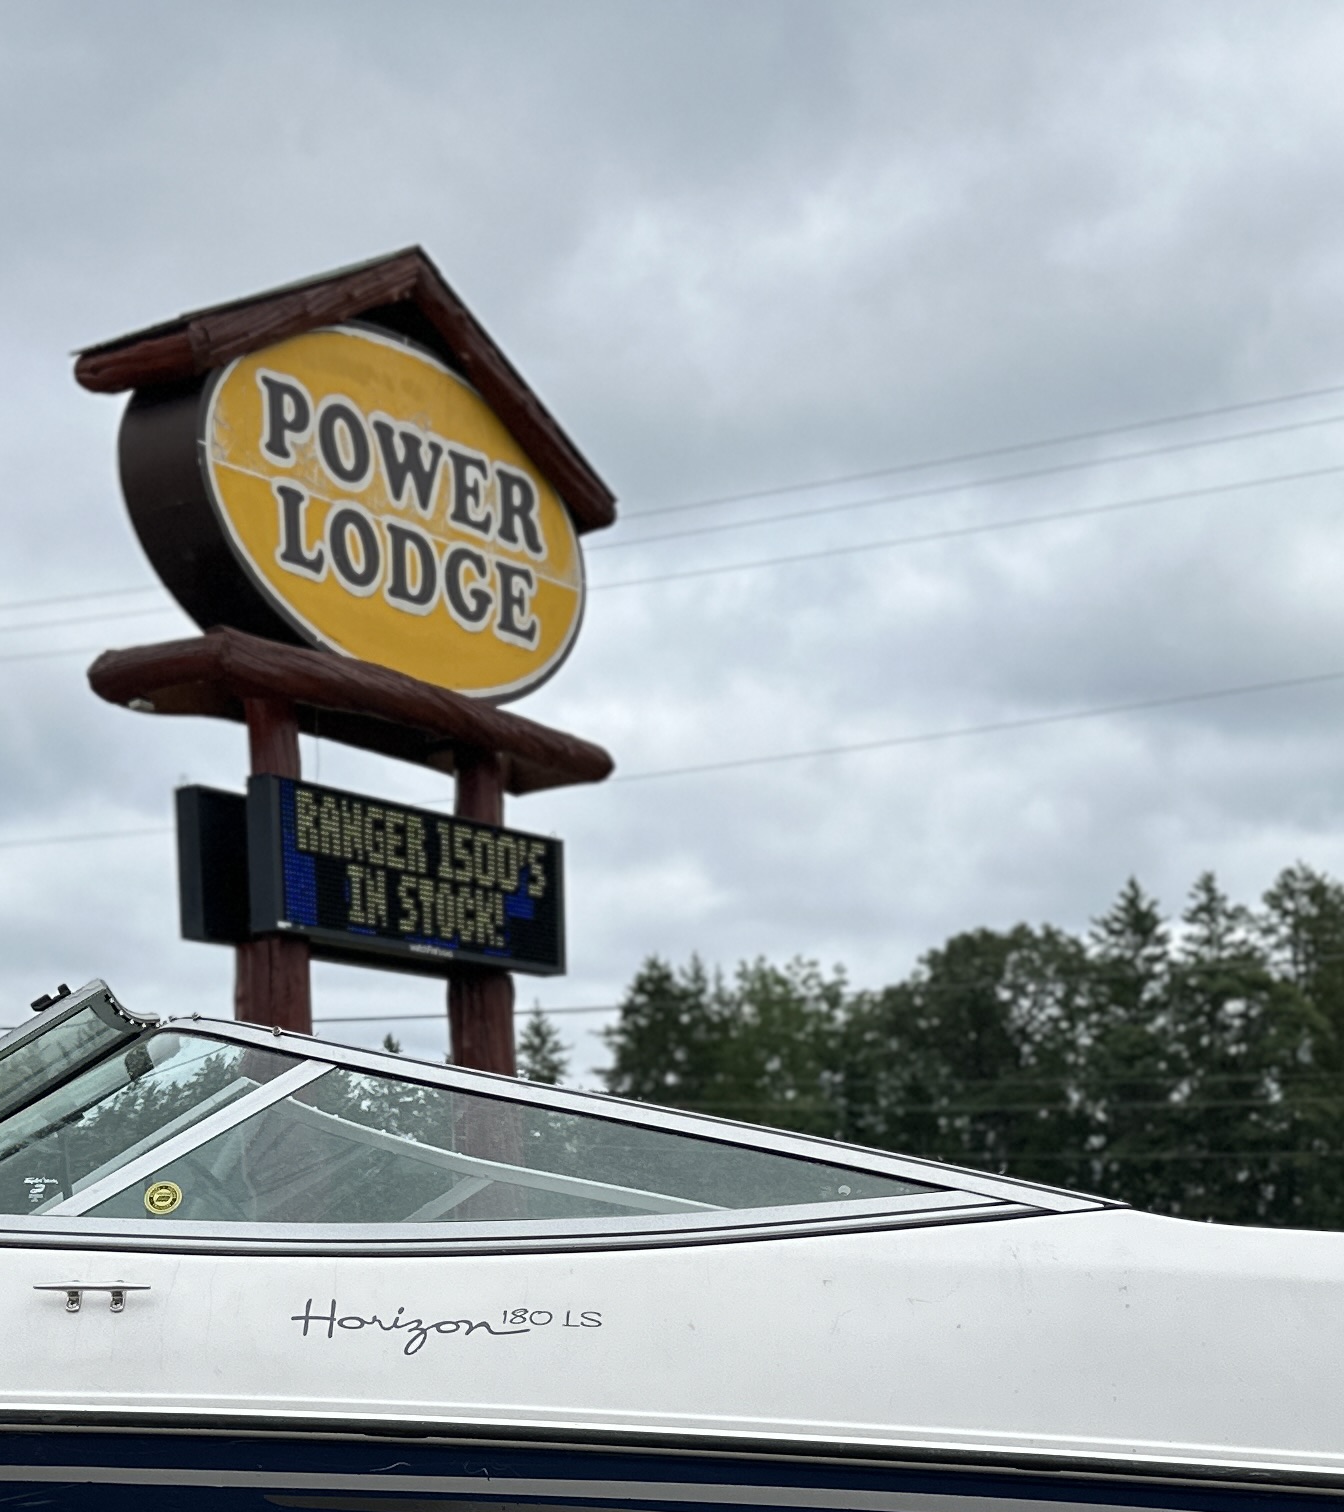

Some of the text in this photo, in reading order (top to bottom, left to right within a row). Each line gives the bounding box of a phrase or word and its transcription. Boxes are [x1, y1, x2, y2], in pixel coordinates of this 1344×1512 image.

[260, 374, 544, 555] POWER
[276, 484, 538, 643] LODGE
[296, 789, 547, 898] RANGER 1500'S
[346, 863, 505, 947] IN STOCK!
[291, 1298, 604, 1355] Horizon 180 LS
